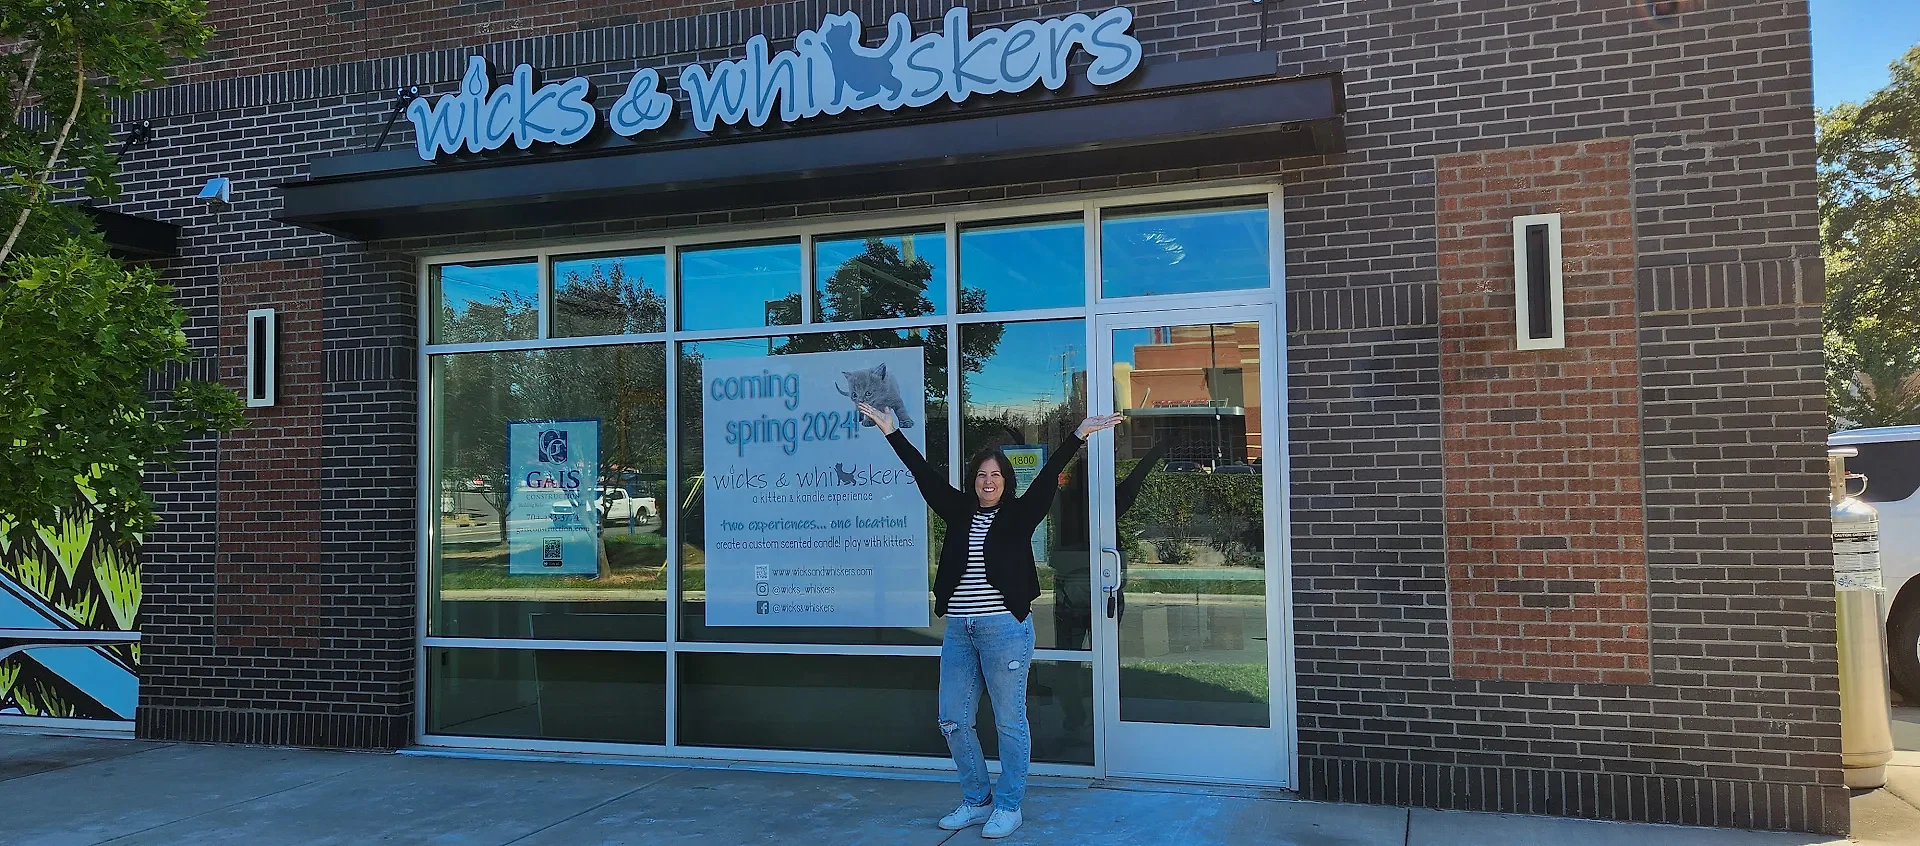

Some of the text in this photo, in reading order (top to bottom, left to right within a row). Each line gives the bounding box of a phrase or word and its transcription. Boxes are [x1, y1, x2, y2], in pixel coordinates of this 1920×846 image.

[412, 7, 1139, 157] wicks & whiskers
[712, 370, 800, 411] coming
[726, 409, 860, 457] spring 2024!
[1013, 455, 1035, 465] 1800
[526, 470, 580, 489] GAIS
[713, 462, 917, 491] wicks & whiskers
[752, 495, 758, 504] a
[760, 492, 787, 504] kitten
[796, 490, 826, 503] kandle
[827, 490, 873, 505] experience
[720, 515, 907, 533] two experiences... one location!
[716, 532, 915, 553] create a custom scented candle! play with kittens!
[772, 566, 873, 577] www.wicksandwhiskers.com
[772, 584, 835, 596] @wicks_whiskers
